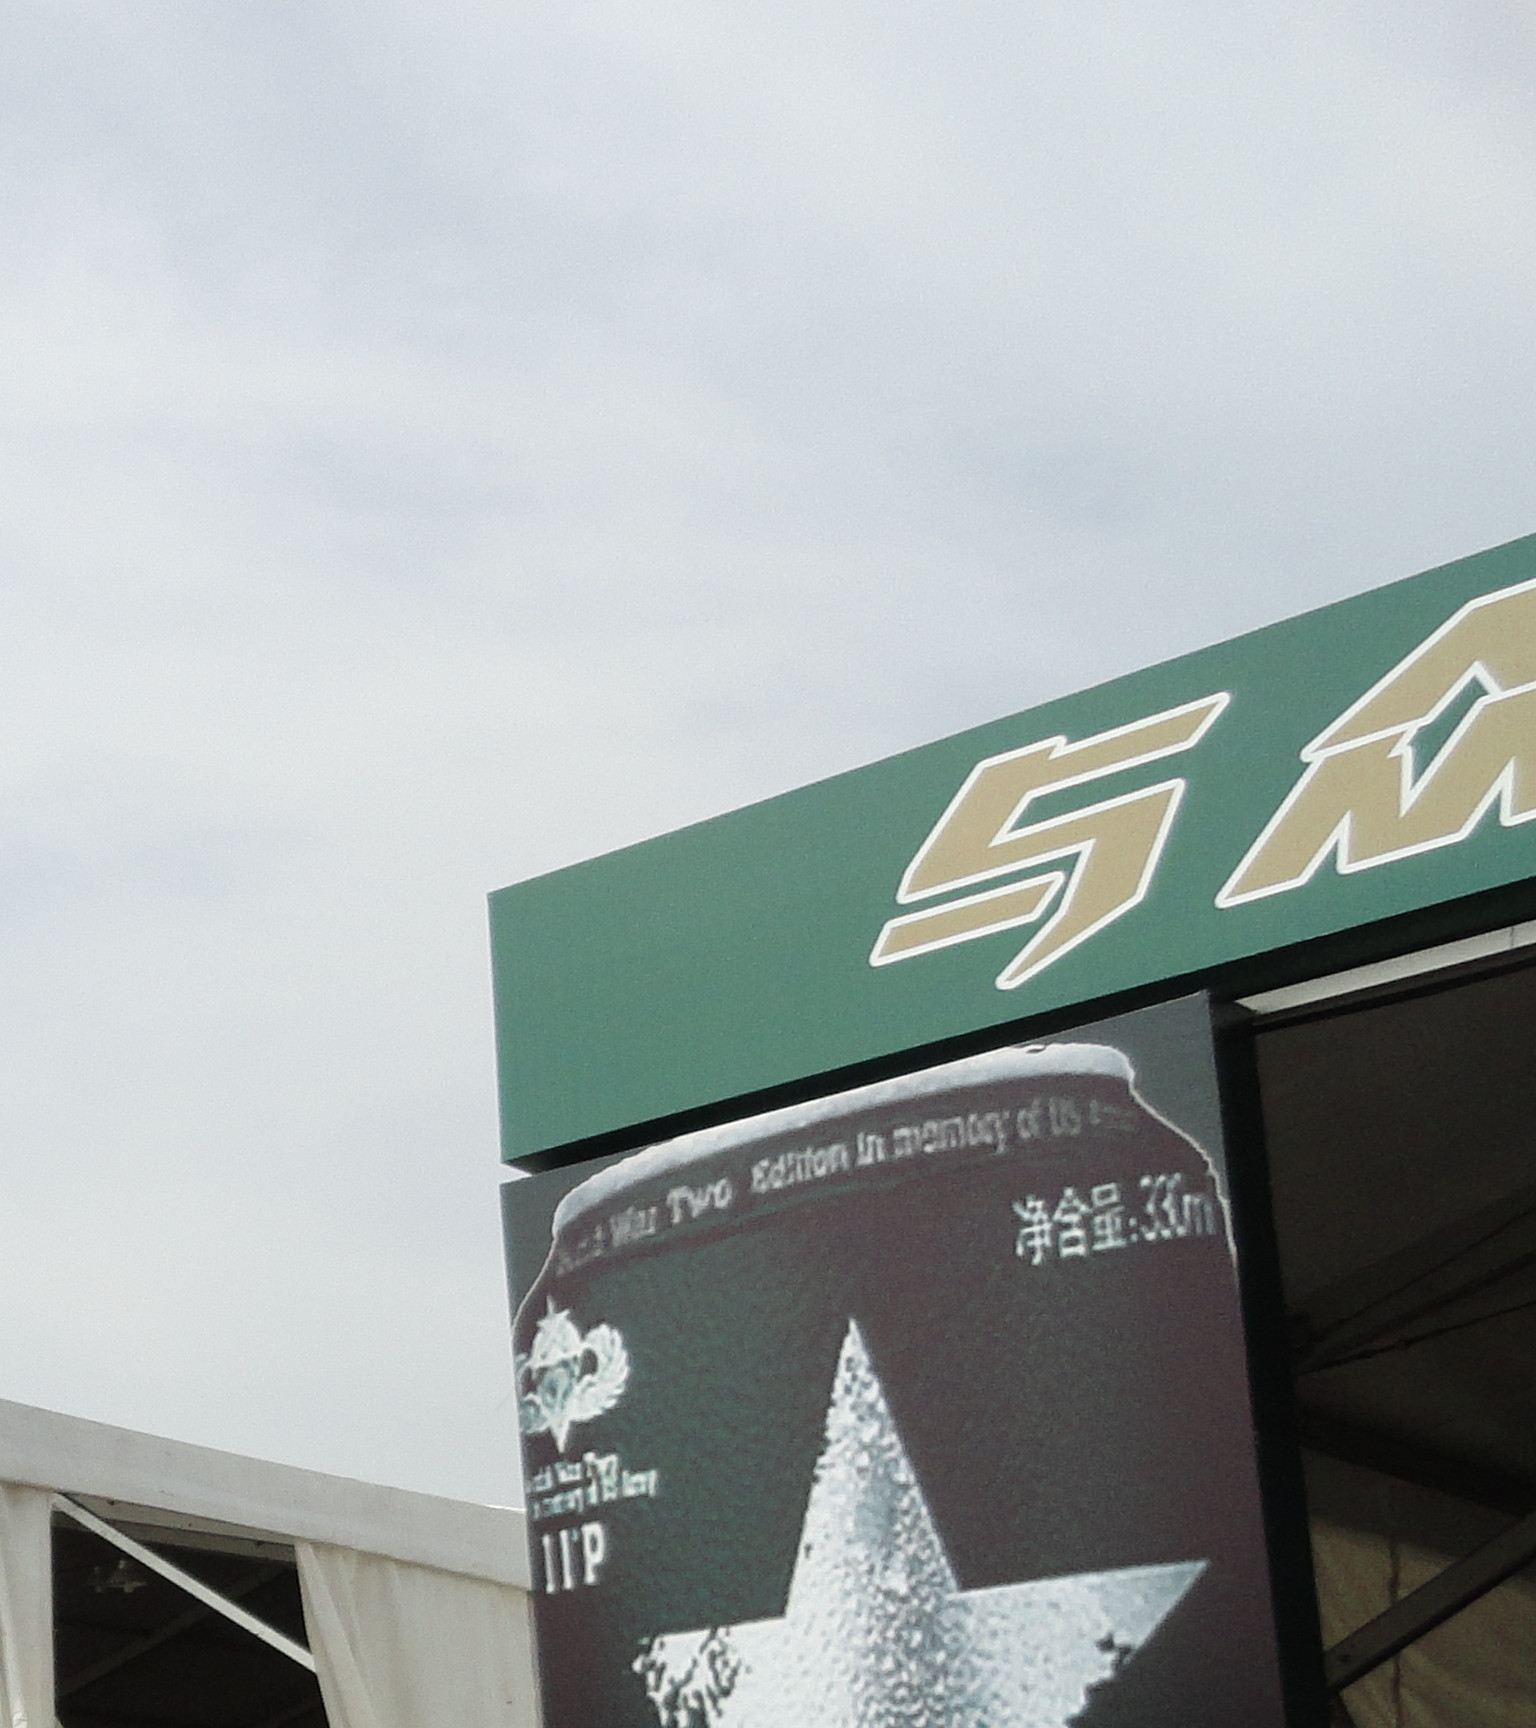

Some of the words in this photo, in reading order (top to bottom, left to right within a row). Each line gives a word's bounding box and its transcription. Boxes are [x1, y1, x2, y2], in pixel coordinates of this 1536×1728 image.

[666, 1177, 735, 1225] Two
[750, 1142, 849, 1195] Edition
[891, 1109, 1009, 1158] memory
